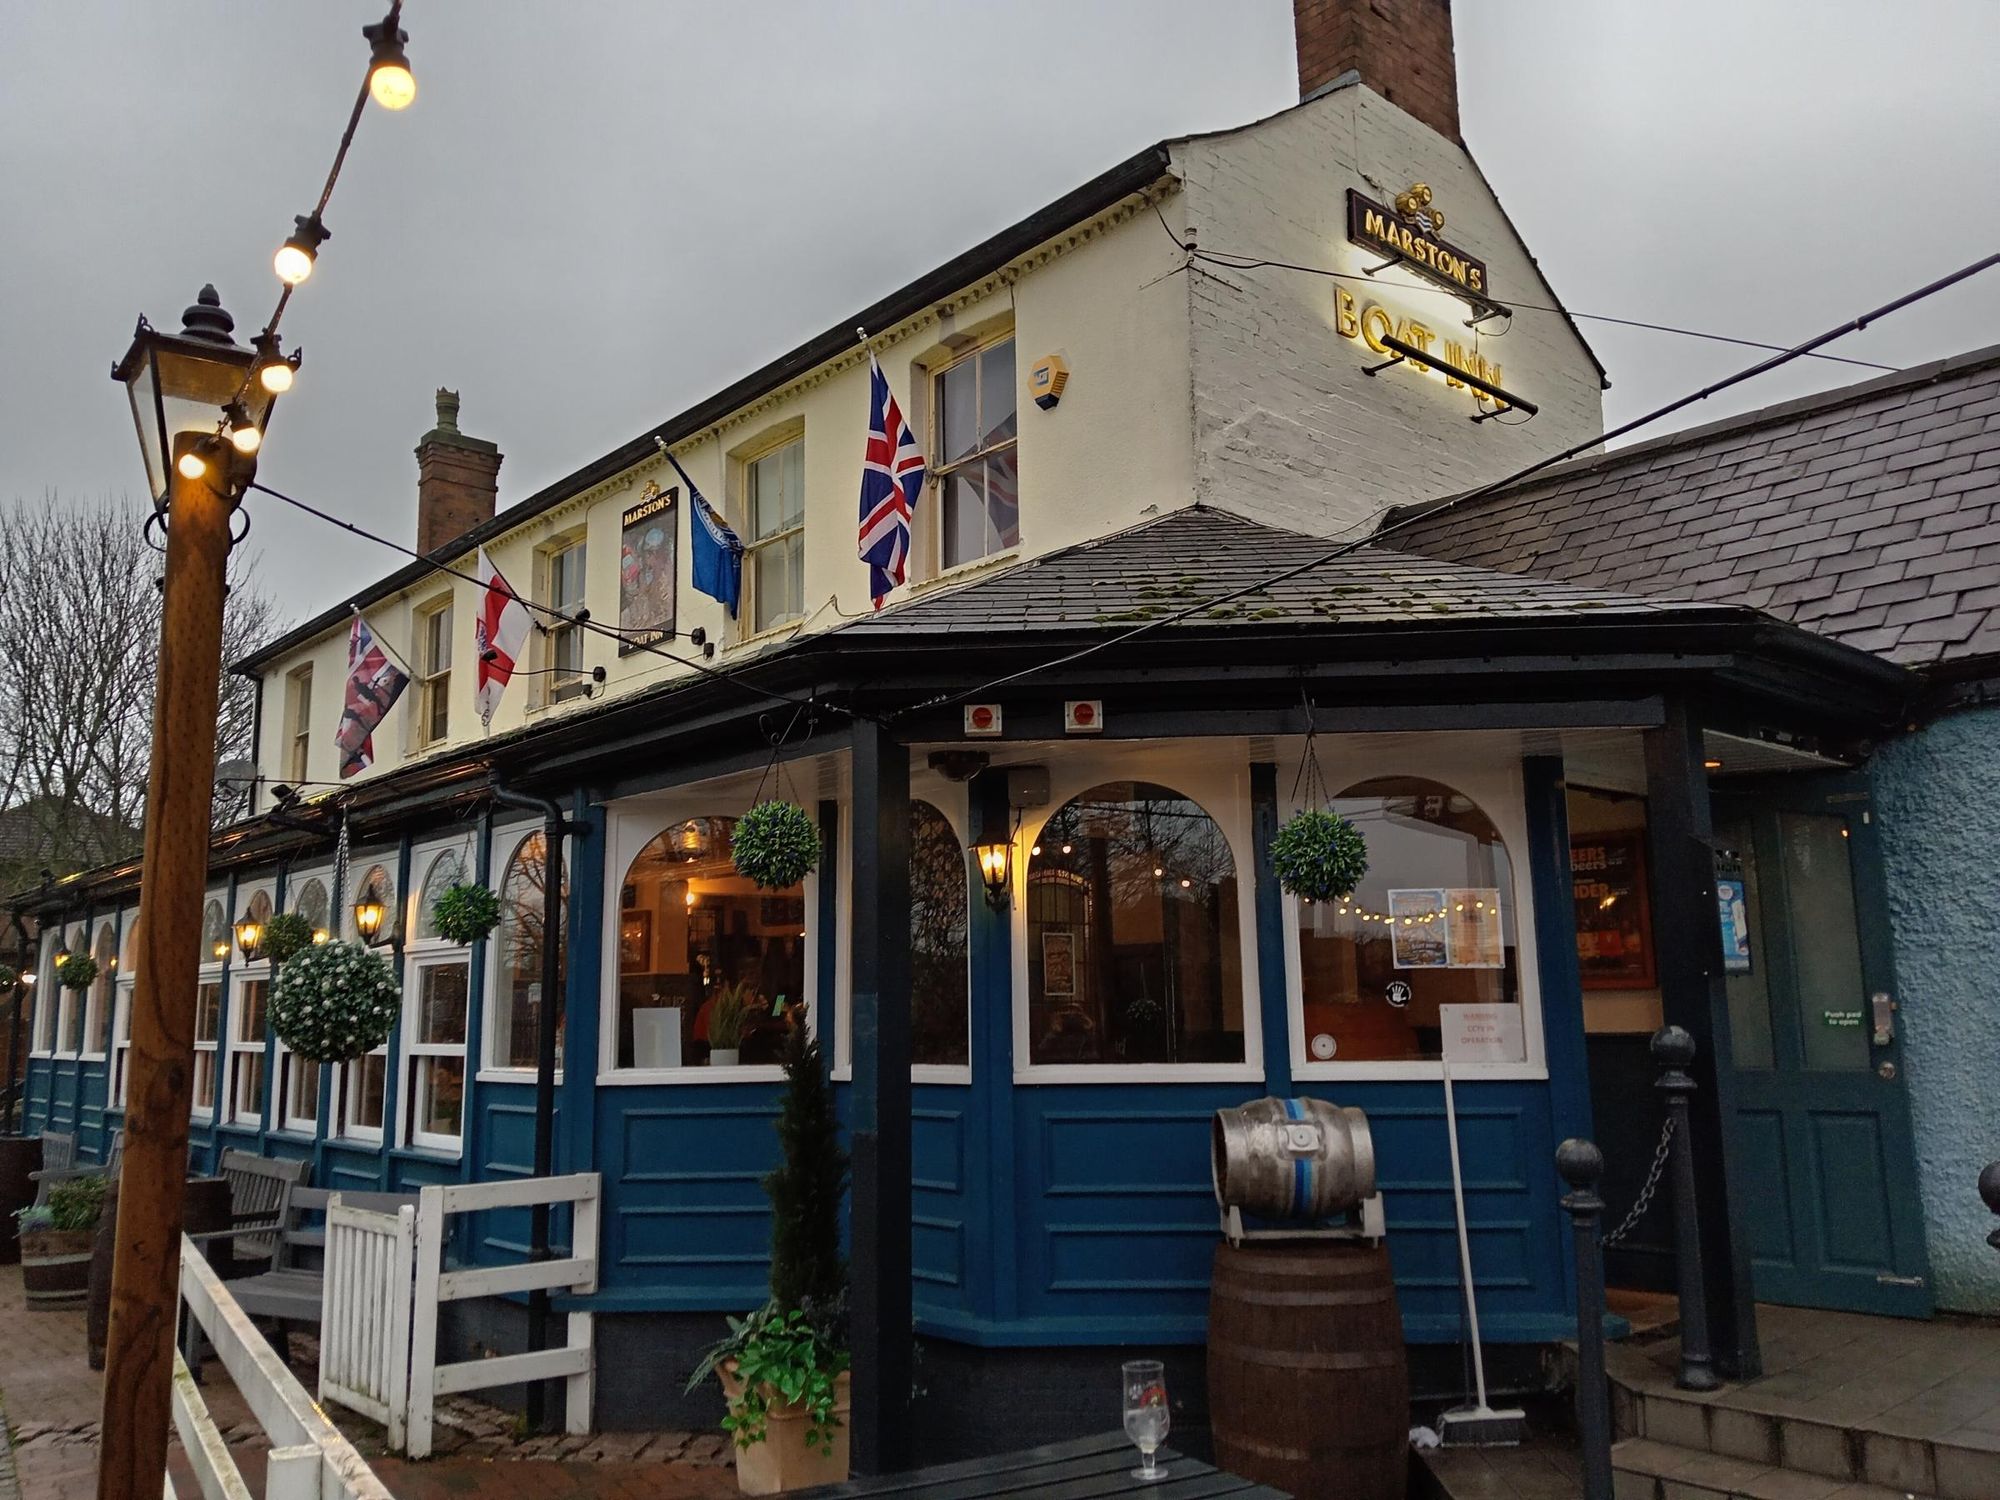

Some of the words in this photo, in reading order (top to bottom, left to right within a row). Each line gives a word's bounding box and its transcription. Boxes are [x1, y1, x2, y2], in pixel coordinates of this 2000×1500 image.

[1365, 208, 1482, 291] MARSTON'S
[1335, 288, 1436, 372] BOAT
[1444, 339, 1506, 410] INN
[623, 494, 671, 527] MARSTON'S
[1571, 847, 1606, 861] EERS
[1574, 883, 1609, 899] IDER
[1846, 1011, 1862, 1019] pad
